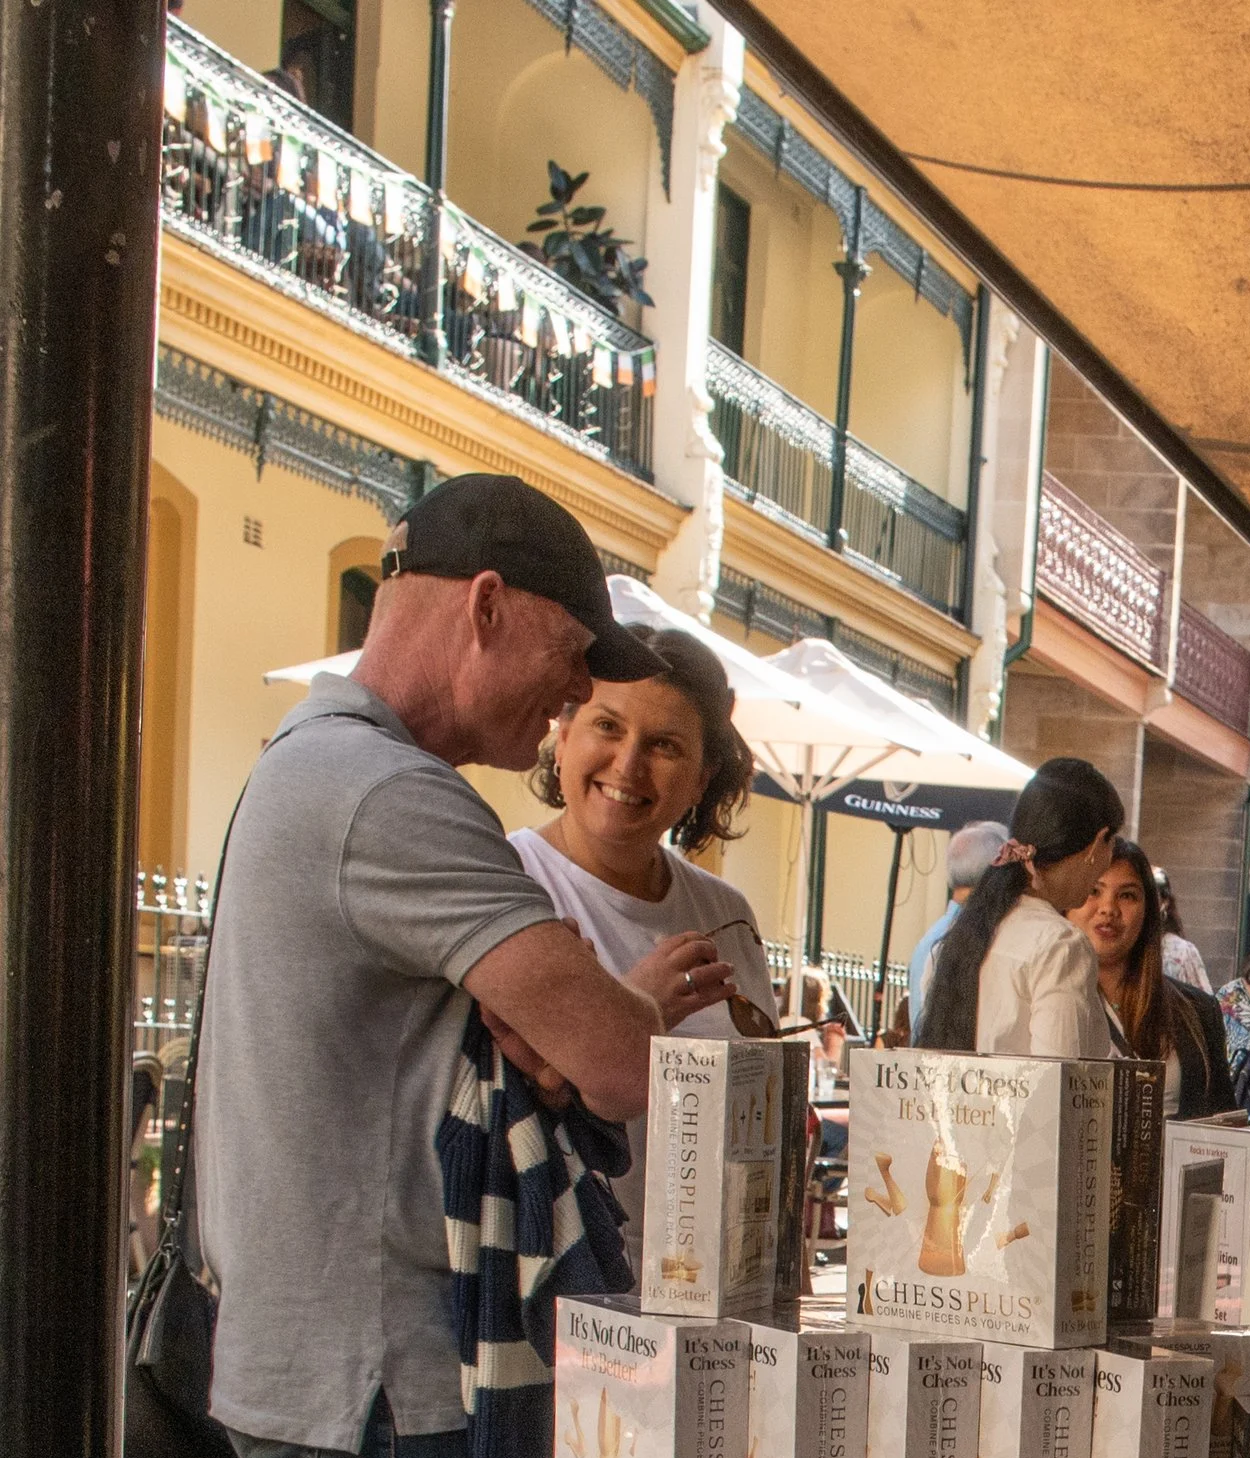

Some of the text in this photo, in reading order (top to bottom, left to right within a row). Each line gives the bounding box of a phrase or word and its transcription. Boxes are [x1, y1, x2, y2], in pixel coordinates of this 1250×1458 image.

[844, 794, 944, 819] GUINNESS
[663, 1068, 710, 1084] Chess
[877, 1306, 1030, 1333] COMBINE PIECES AS YOU PLAY
[570, 1313, 657, 1358] It's Not Chess
[917, 1357, 973, 1371] It's Not
[922, 1374, 968, 1389] Chess
